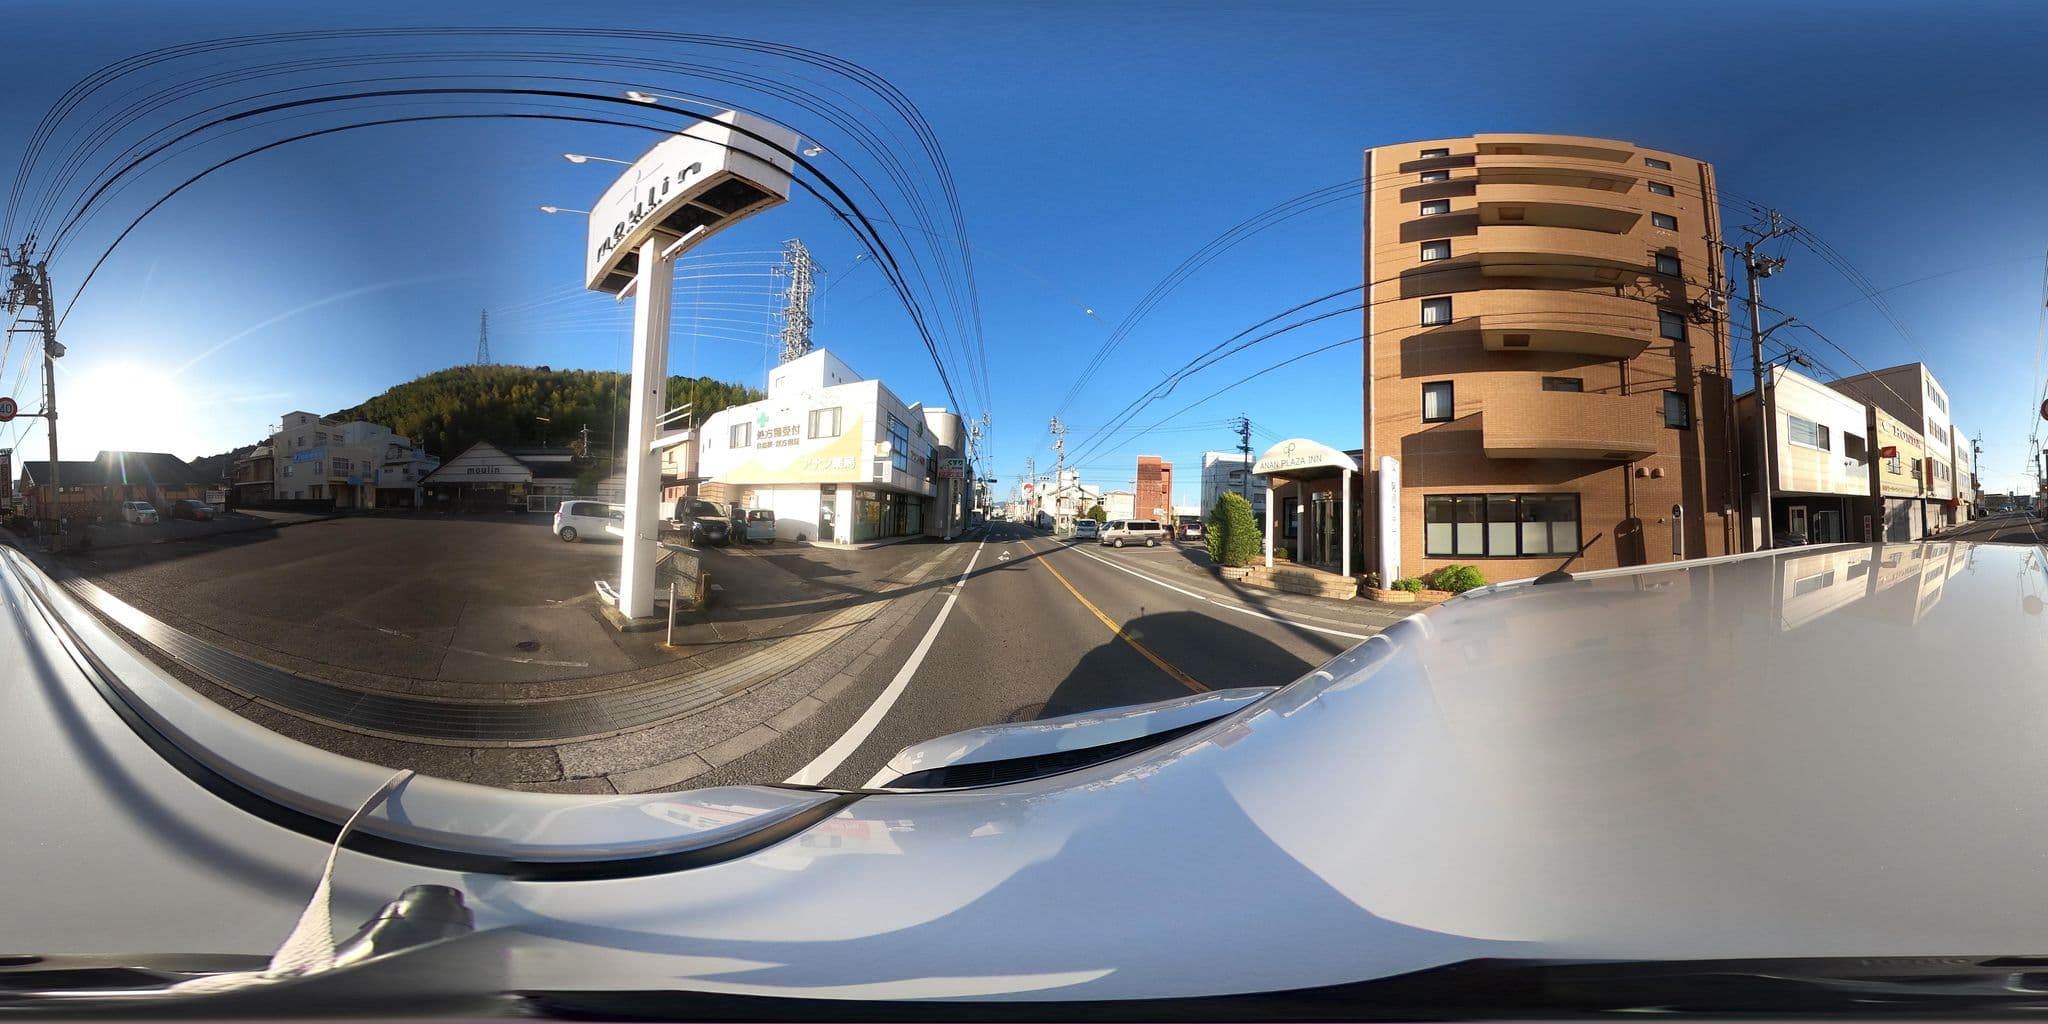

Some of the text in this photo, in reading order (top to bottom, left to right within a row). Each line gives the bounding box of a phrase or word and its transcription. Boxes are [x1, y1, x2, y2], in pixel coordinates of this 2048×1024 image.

[1260, 454, 1322, 470] ANAN PLAZA INN
[467, 465, 500, 475] moulin
